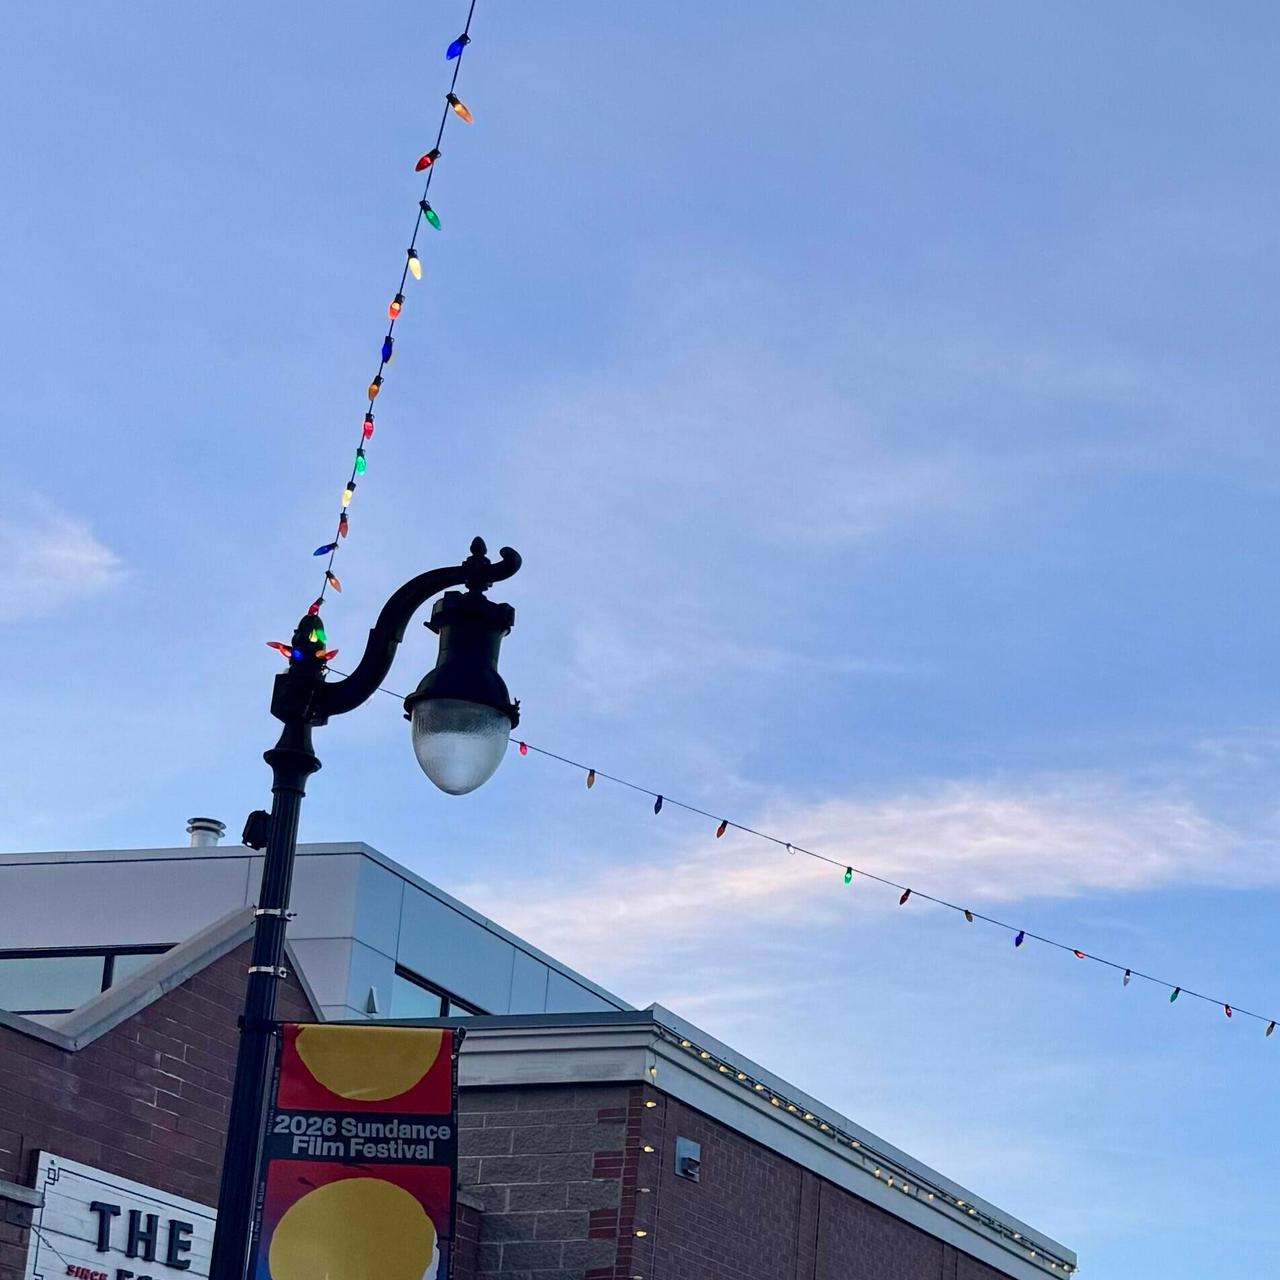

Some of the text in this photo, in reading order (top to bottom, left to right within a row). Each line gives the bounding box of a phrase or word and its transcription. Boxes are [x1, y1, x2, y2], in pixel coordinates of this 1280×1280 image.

[273, 1115, 450, 1140] 2026 Sundance
[292, 1136, 434, 1159] Film Festival
[90, 1201, 193, 1270] THE
